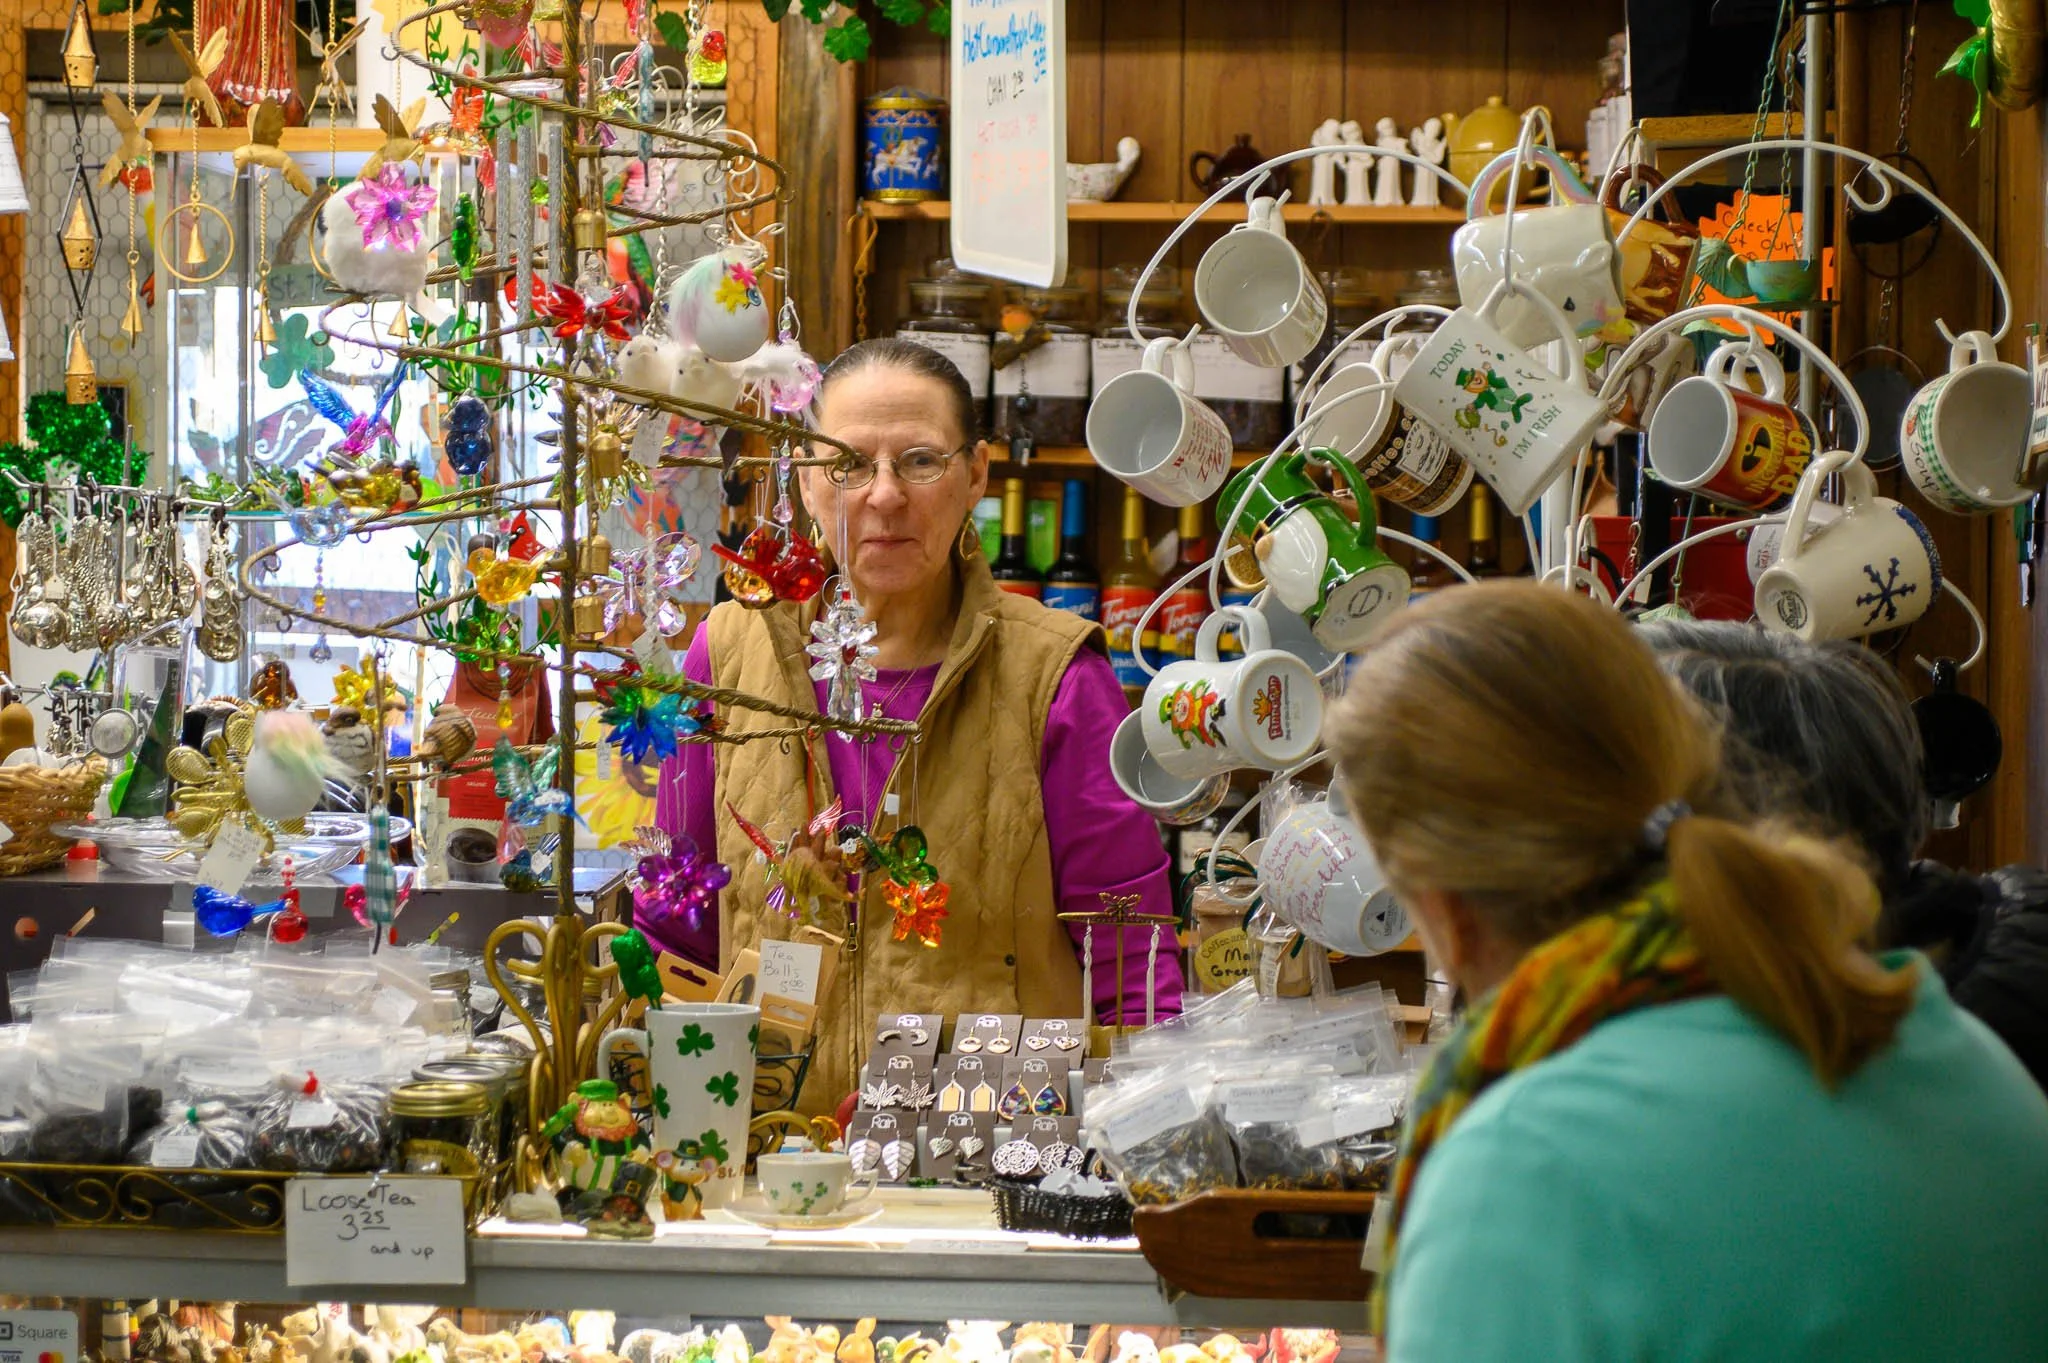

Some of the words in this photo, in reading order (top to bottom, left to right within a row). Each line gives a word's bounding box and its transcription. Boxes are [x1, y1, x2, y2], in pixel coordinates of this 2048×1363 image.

[1430, 338, 1467, 380] TODAY
[1512, 437, 1533, 460] I'M
[1527, 405, 1562, 440] IRISH
[1771, 430, 1811, 495] DAD
[1910, 441, 1941, 492] Soup
[768, 945, 794, 960] Tea
[763, 960, 802, 978] Balls
[888, 1055, 914, 1070] Rain
[957, 1055, 983, 1070] Rain
[1023, 1058, 1048, 1072] Rain
[872, 1113, 897, 1129] Rain
[948, 1112, 974, 1126] Rain
[1033, 1116, 1058, 1131] Rain
[379, 1183, 416, 1206] Tea
[370, 1241, 401, 1255] and
[411, 1246, 435, 1260] up
[17, 1324, 69, 1341] Square
